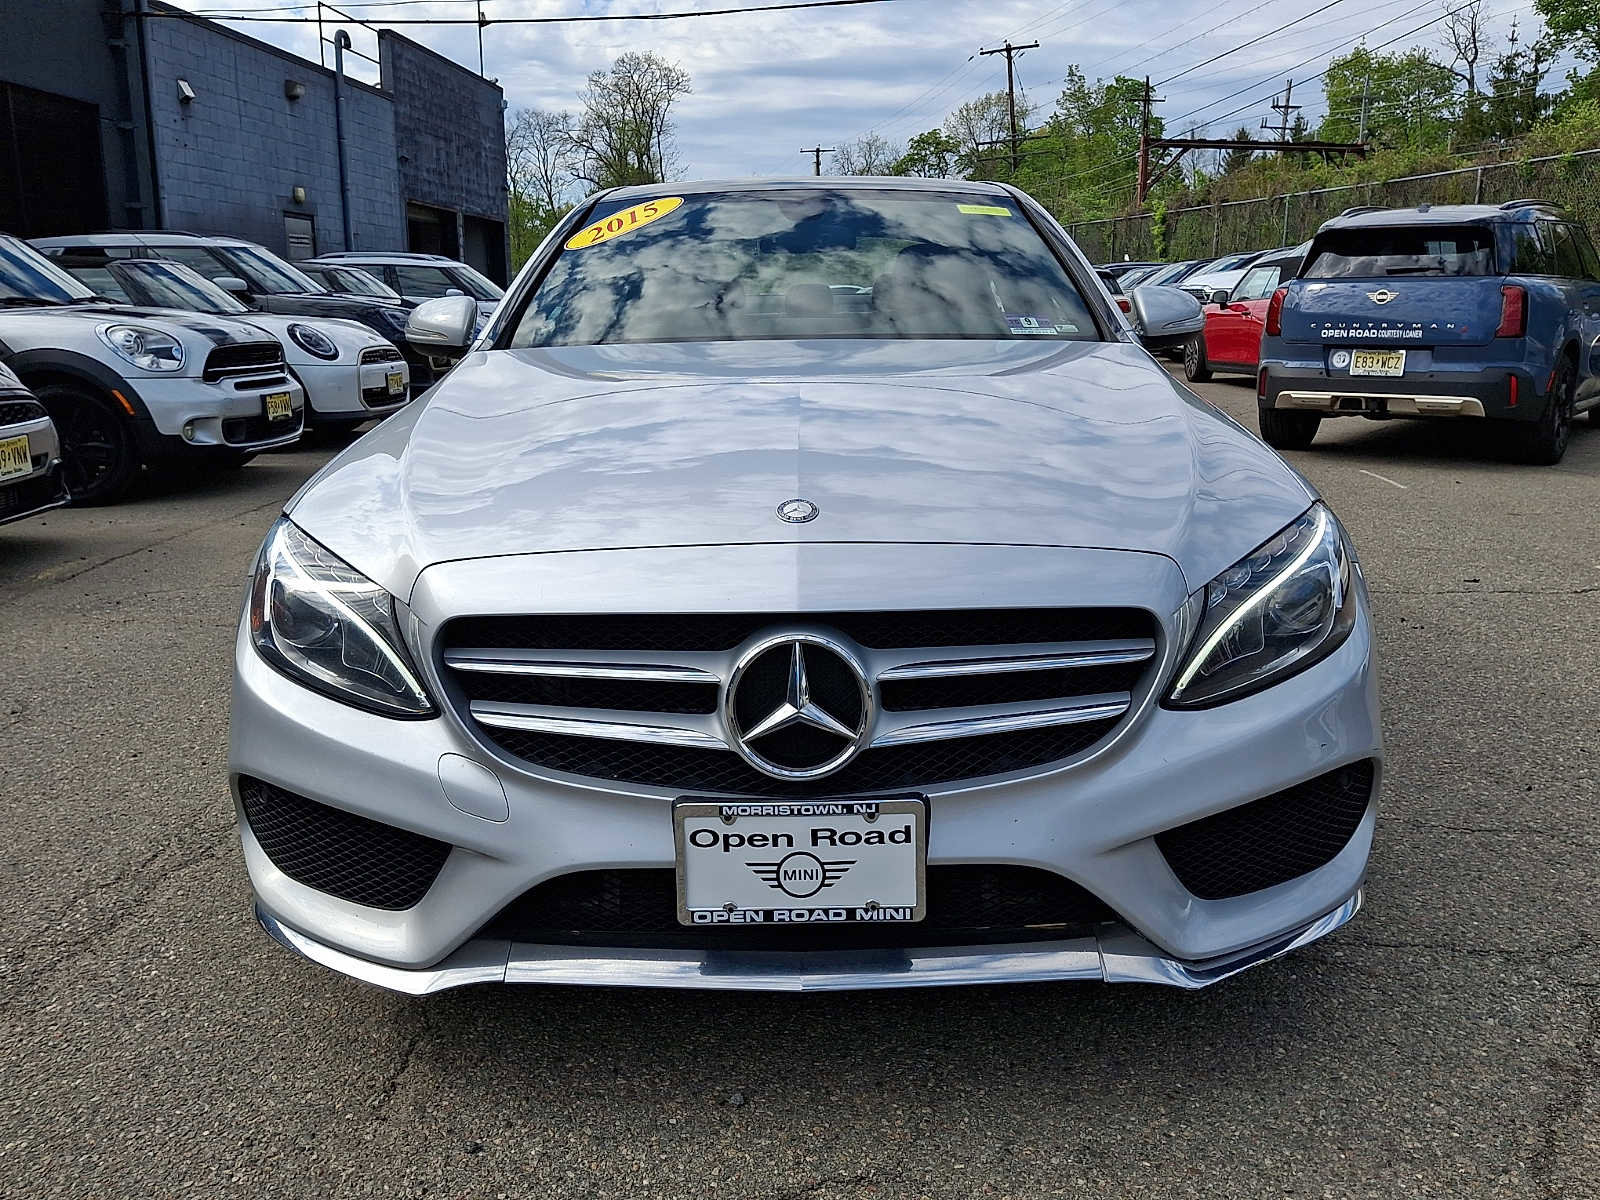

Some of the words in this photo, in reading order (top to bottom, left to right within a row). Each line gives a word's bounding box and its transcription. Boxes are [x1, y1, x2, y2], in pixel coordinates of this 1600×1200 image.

[588, 203, 658, 242] 2015
[1321, 329, 1348, 338] OPEN
[1349, 329, 1378, 338] ROAD
[1378, 329, 1404, 338] COURTESY
[1403, 330, 1423, 339] LOANER
[722, 804, 847, 816] MORRISTOWN,
[853, 803, 877, 814] NJ
[689, 828, 794, 853] Open
[810, 824, 912, 847] Road
[783, 868, 819, 881] MINI
[693, 910, 764, 923] OPEN
[773, 909, 847, 922] ROAD
[855, 908, 911, 920] MINI
